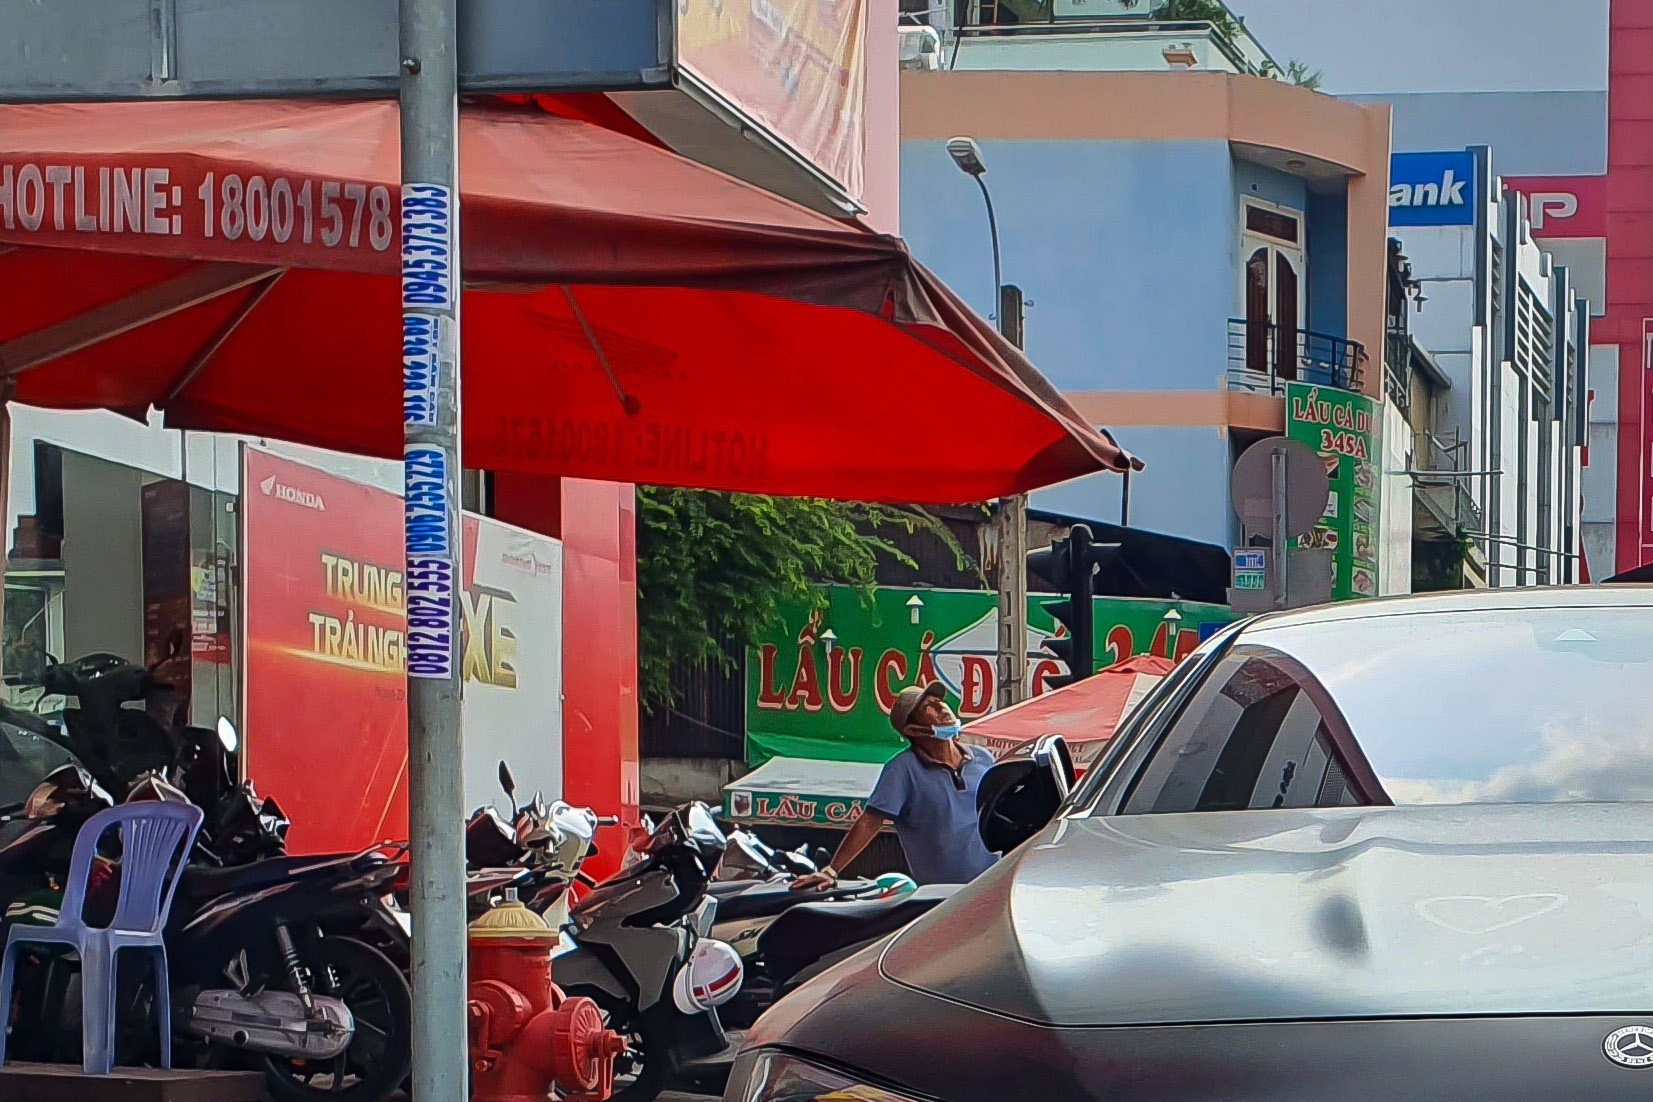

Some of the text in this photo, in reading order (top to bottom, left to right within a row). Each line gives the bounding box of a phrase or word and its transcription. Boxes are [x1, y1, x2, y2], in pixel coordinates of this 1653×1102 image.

[0, 163, 393, 252] HOTLINE: 18001578
[1521, 190, 1578, 230] P
[1321, 428, 1368, 460] 345A
[276, 483, 326, 512] HONDA
[406, 559, 452, 675] 0812.802.555
[460, 590, 518, 690] XE
